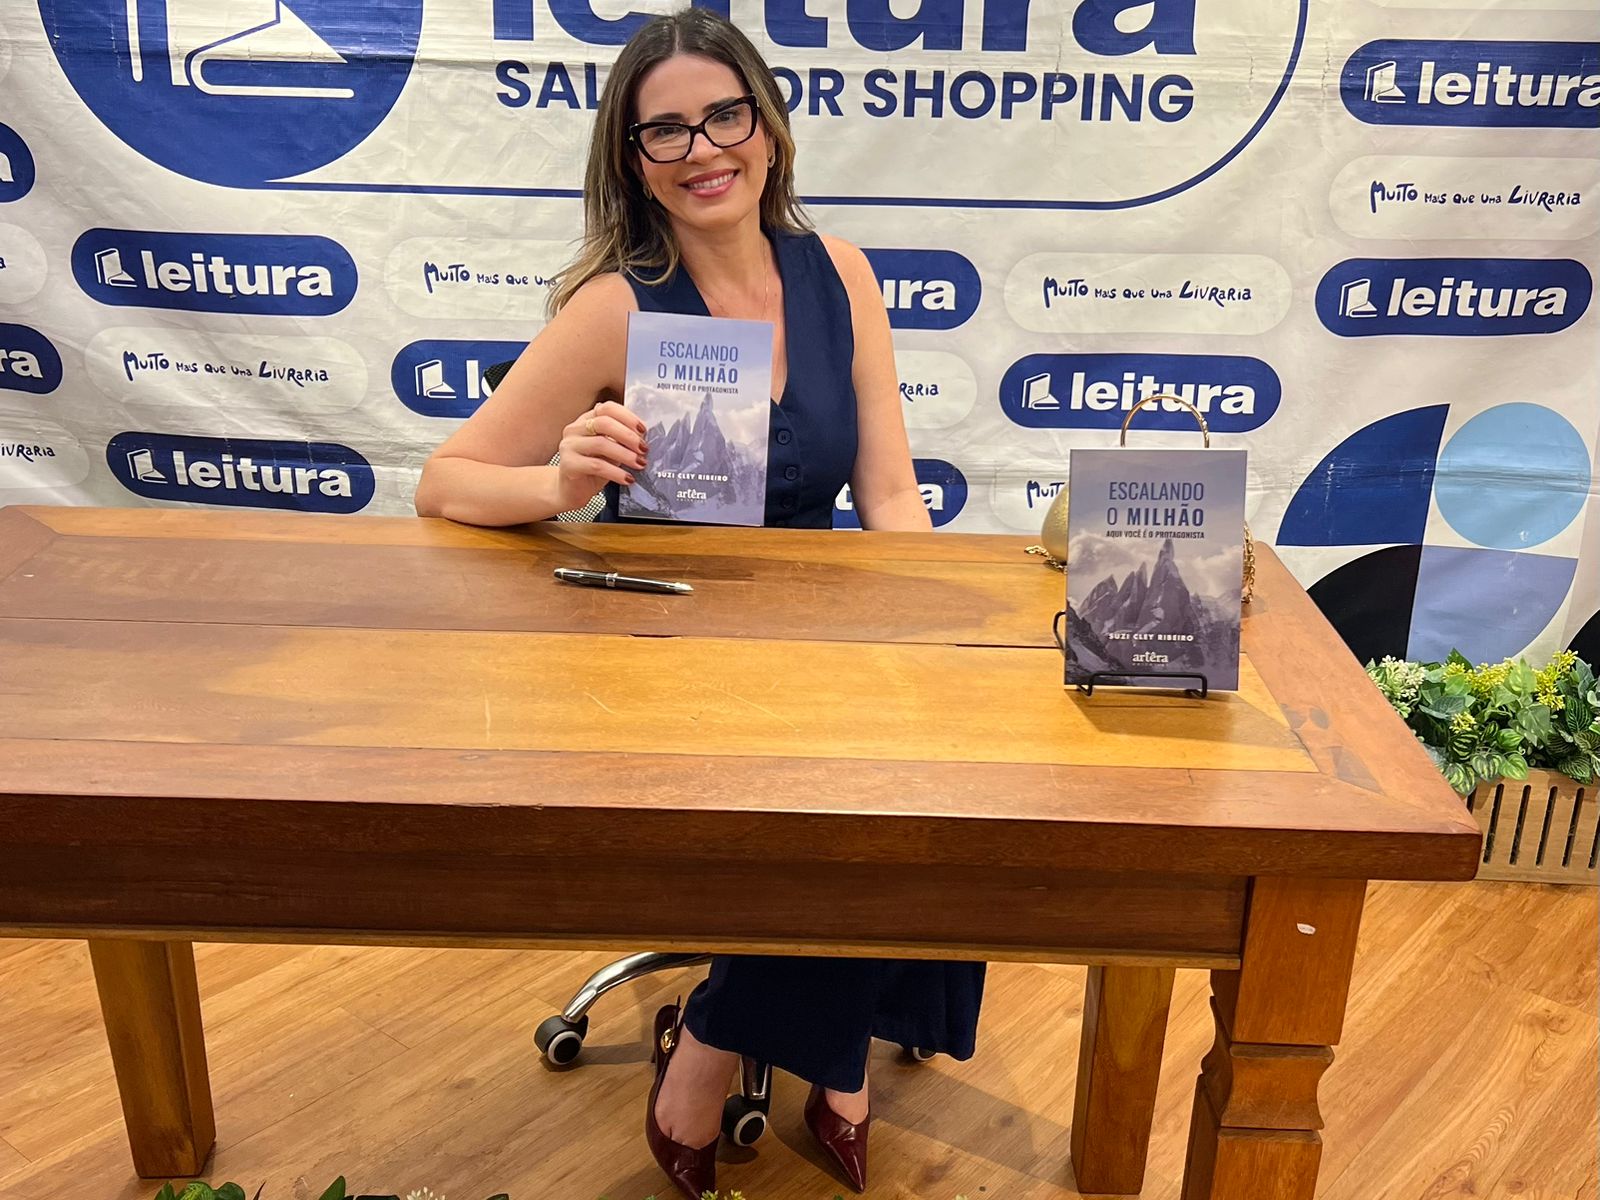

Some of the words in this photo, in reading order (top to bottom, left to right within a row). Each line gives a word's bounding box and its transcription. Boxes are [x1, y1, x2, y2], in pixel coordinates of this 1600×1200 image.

[496, 60, 844, 117] SALOR
[863, 69, 1194, 122] SHOPPING
[1417, 61, 1600, 107] leitura
[141, 250, 334, 297] leitura
[1387, 278, 1567, 317] leitura
[660, 341, 739, 362] ESCALANDO
[658, 363, 667, 379] O
[675, 364, 738, 384] MILHÃO
[672, 383, 686, 391] VOCÊ
[698, 386, 738, 394] PROTAGONISTA
[900, 382, 939, 402] RaRia
[1070, 372, 1255, 415] leitura
[0, 443, 55, 462] ivRaRia
[173, 451, 352, 497] leitura
[698, 474, 728, 482] RIBEIRO
[1027, 480, 1066, 508] MuiT
[1109, 482, 1204, 501] ESCALANDO
[1107, 508, 1117, 525] O
[1127, 504, 1204, 526] MILHÃO
[1106, 530, 1122, 538] AQUI
[1124, 529, 1141, 538] VOCÊ
[1155, 531, 1204, 539] PROTAGONISTA
[1133, 633, 1154, 641] CLEY
[1157, 634, 1194, 642] RIBEIRO
[1132, 651, 1169, 663] artêra
